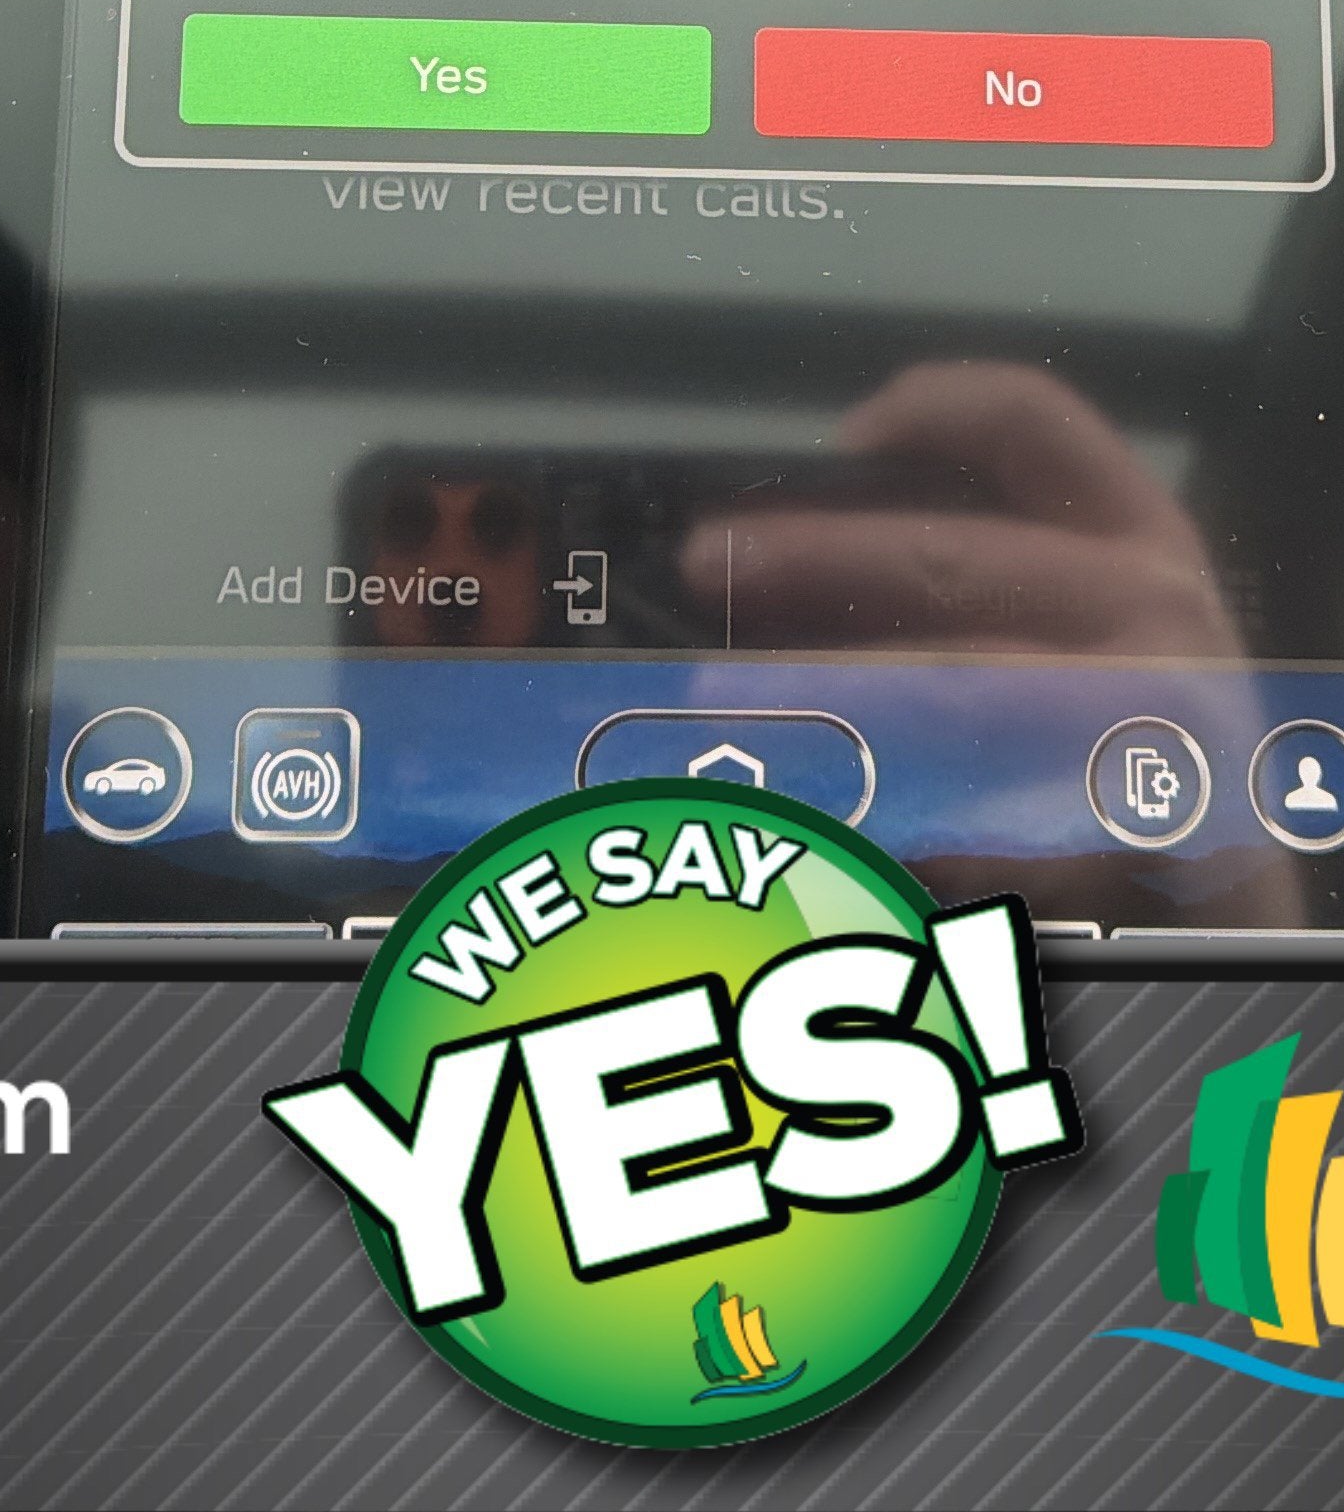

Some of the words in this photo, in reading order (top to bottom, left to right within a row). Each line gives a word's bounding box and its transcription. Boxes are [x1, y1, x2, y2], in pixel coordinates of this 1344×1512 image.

[409, 56, 488, 95] Yes
[986, 70, 1042, 107] No
[322, 175, 453, 212] view
[477, 176, 668, 216] recent
[216, 565, 303, 605] Add
[323, 565, 481, 608] Device
[272, 769, 320, 800] AVH
